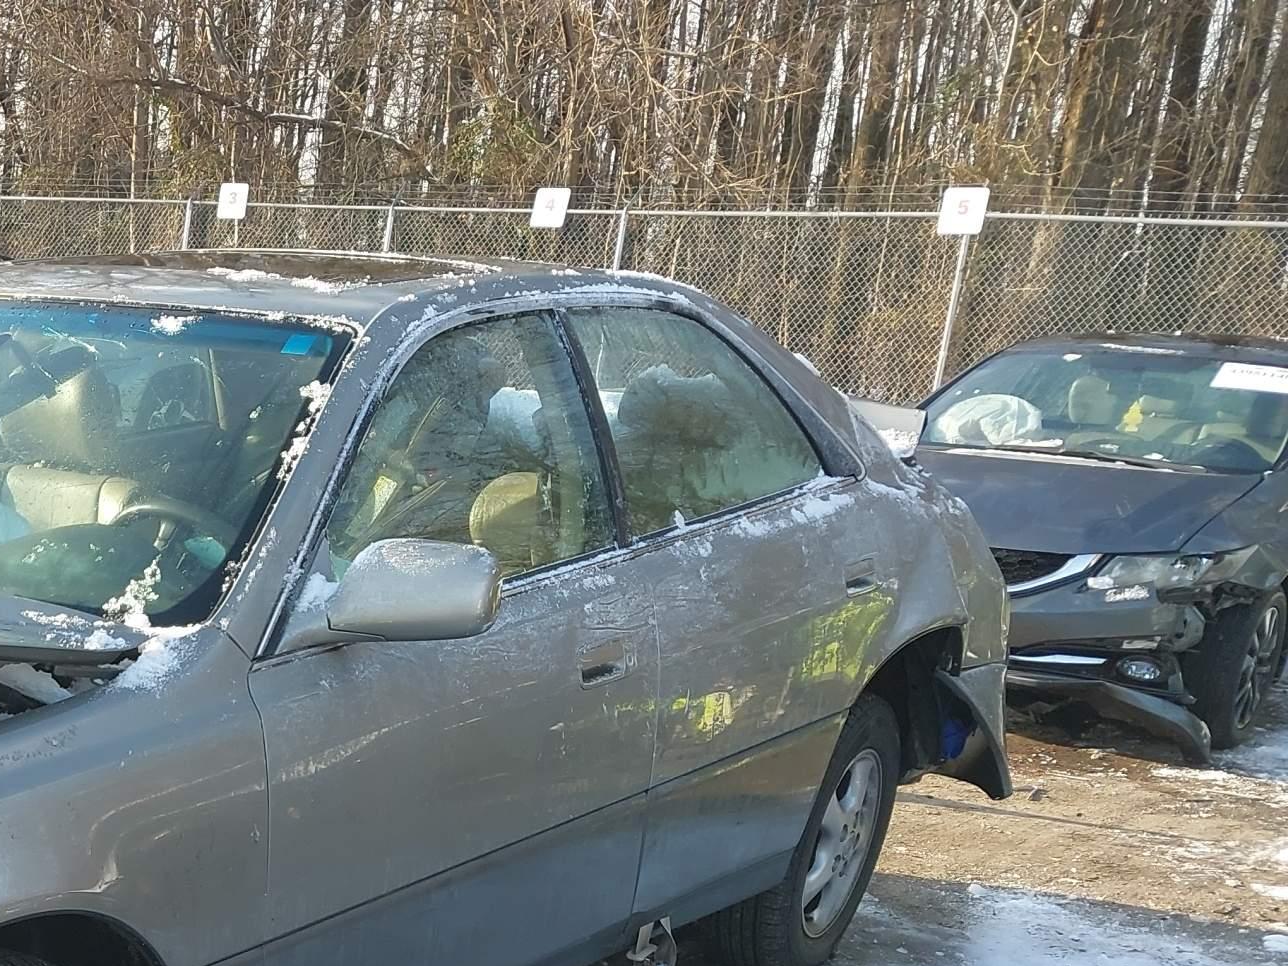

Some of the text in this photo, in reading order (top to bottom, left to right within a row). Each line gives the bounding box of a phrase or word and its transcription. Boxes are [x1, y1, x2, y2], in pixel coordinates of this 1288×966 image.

[229, 191, 237, 205] 3
[545, 197, 556, 211] 4
[958, 199, 971, 215] 5
